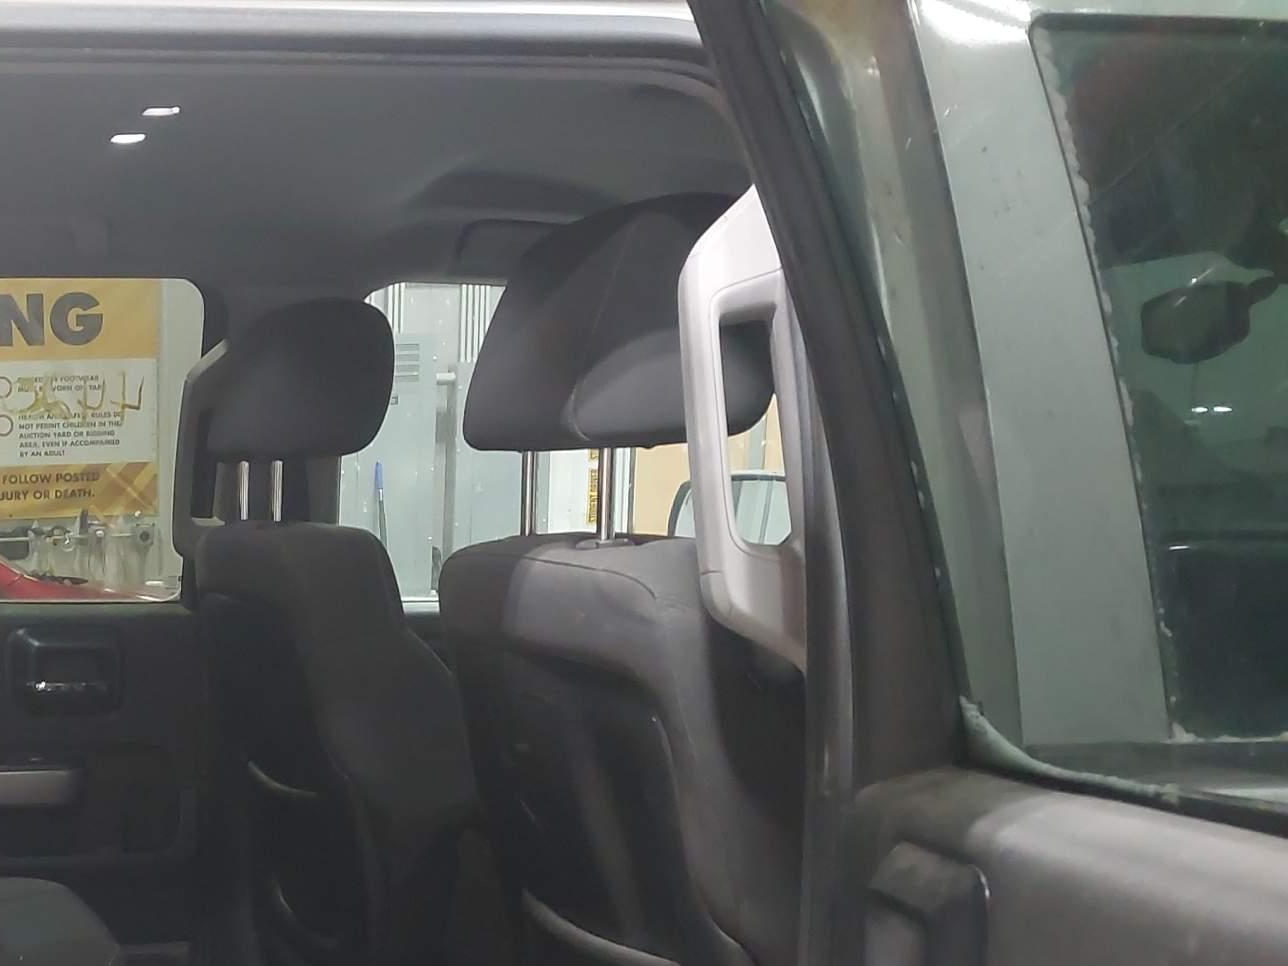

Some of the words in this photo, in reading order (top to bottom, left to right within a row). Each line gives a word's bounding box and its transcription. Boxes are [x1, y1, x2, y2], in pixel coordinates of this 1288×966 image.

[19, 432, 51, 440] AUCTION
[42, 440, 60, 448] EVEN
[2, 472, 52, 485] FOLLOW
[55, 470, 101, 483] POSTED
[32, 489, 52, 501] OR
[54, 487, 96, 500] DEATH.
